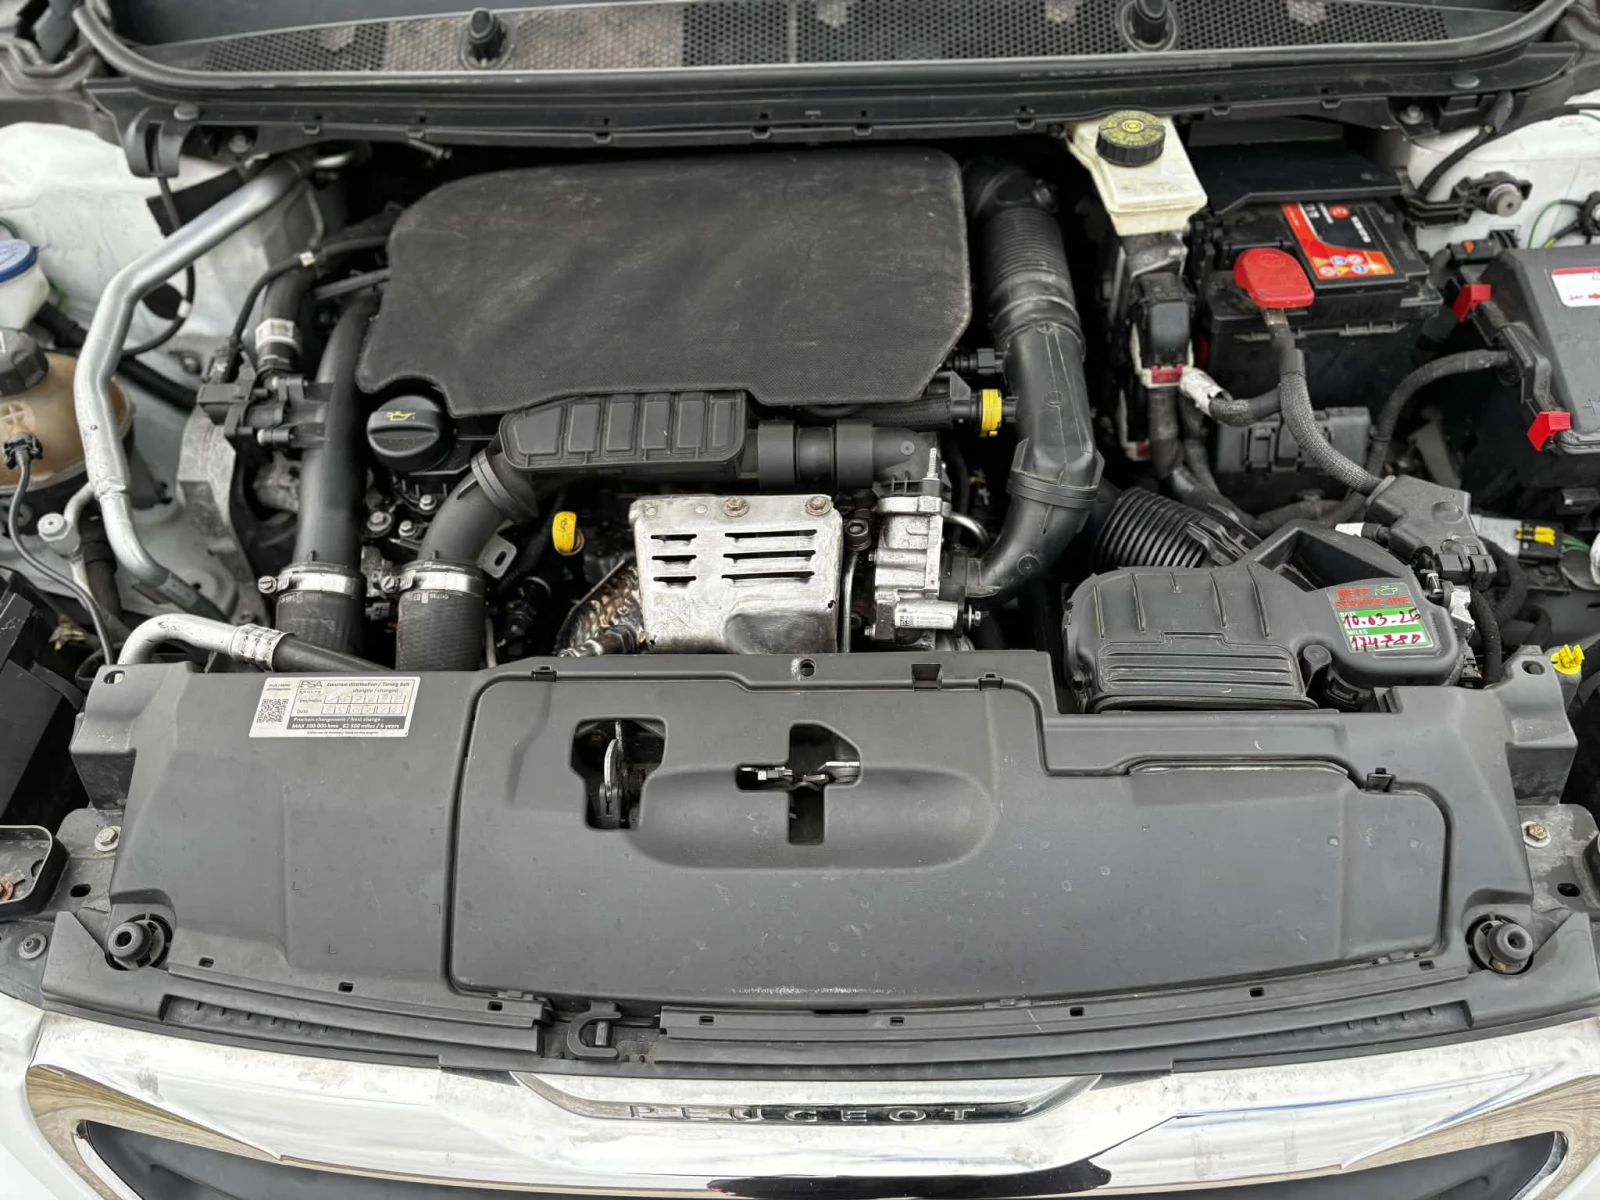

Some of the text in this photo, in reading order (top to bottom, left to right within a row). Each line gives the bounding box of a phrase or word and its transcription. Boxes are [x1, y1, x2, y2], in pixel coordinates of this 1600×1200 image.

[1335, 597, 1384, 609] SERVICE
[300, 680, 323, 688] PSA
[628, 1105, 977, 1123] PEUGEOT
